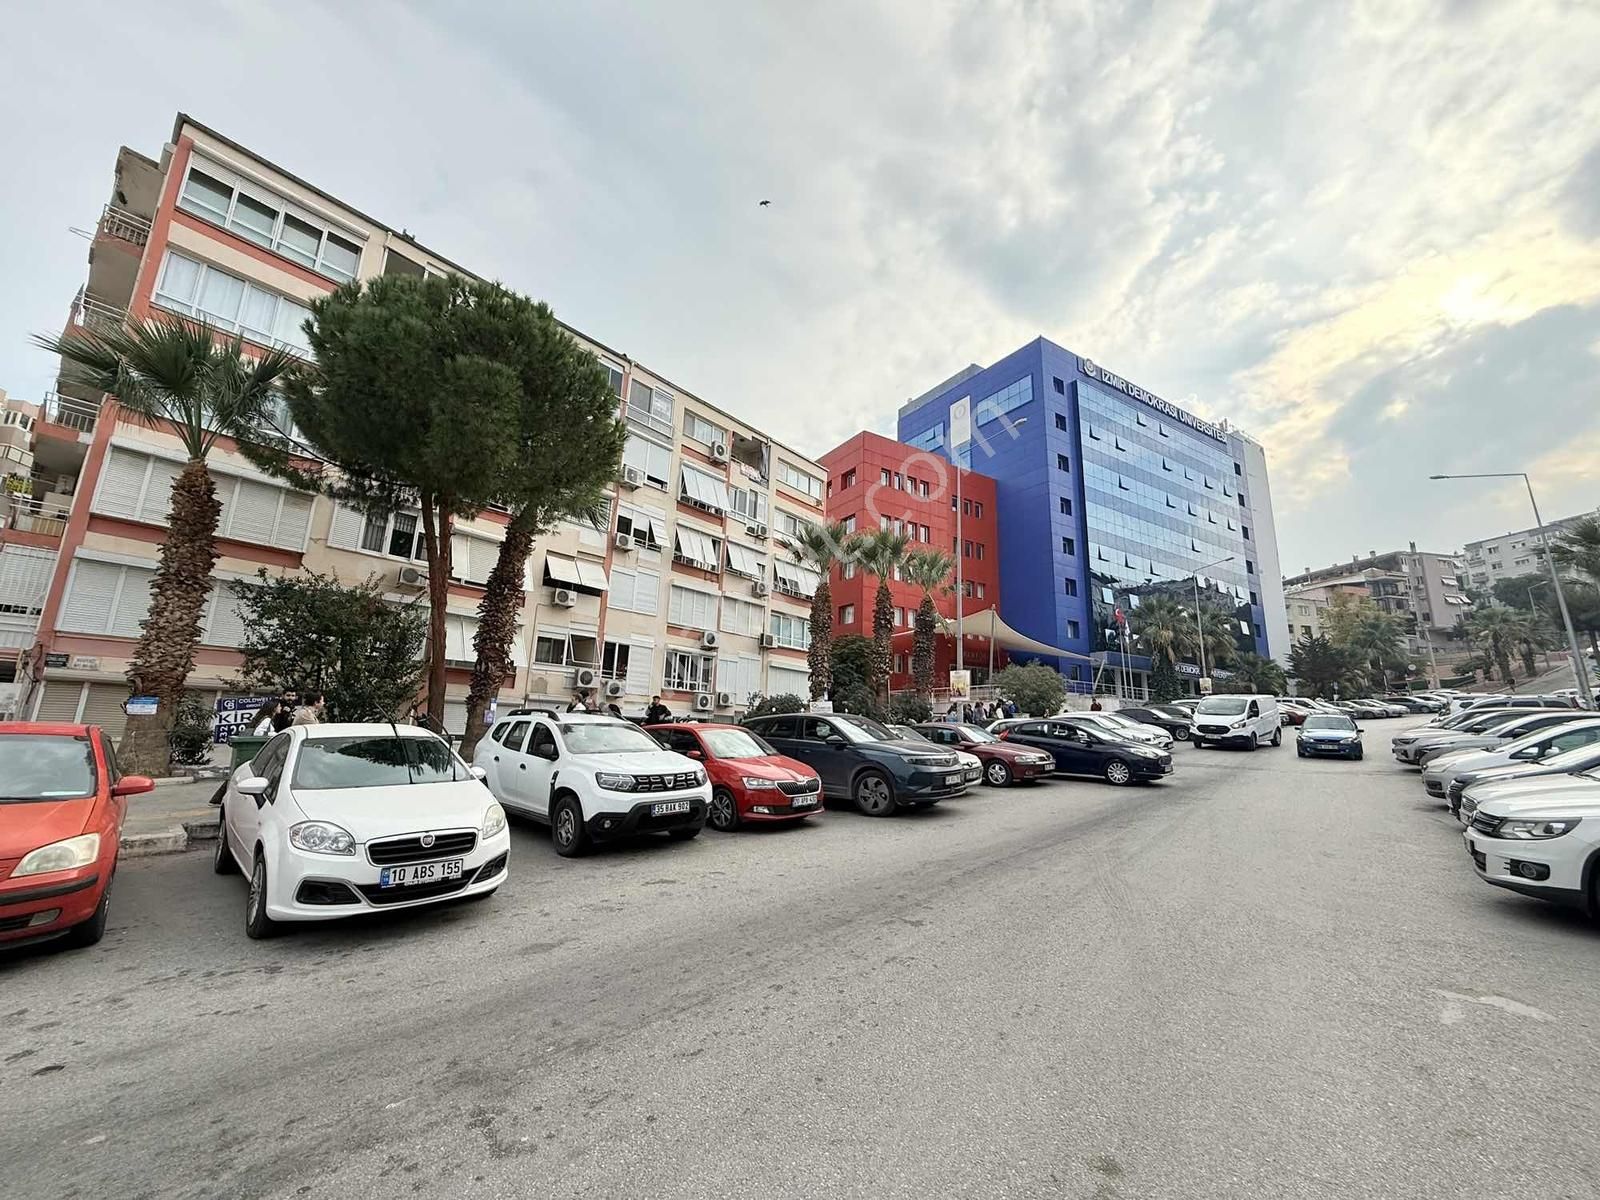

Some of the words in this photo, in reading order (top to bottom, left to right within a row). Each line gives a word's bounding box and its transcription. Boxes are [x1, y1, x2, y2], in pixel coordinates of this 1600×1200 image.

[391, 869, 406, 882] 10
[412, 866, 435, 880] ABS
[441, 862, 460, 876] 155
